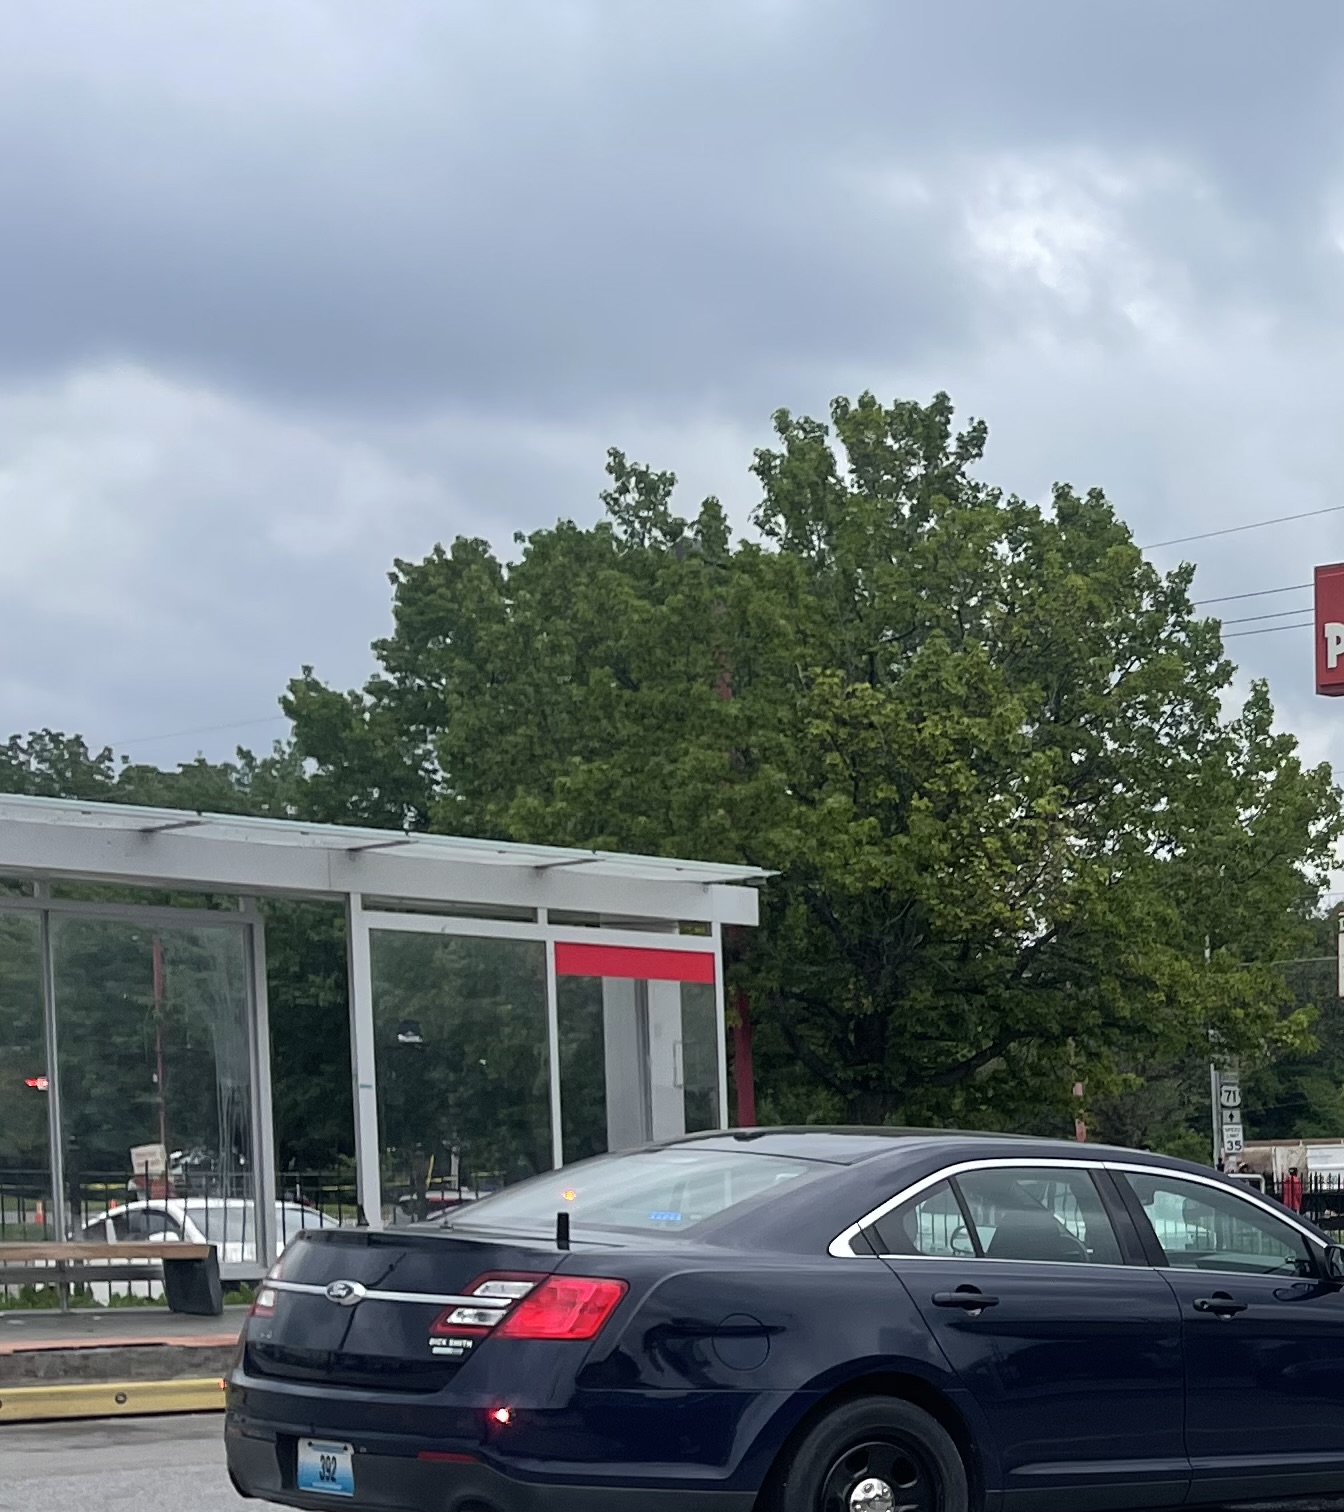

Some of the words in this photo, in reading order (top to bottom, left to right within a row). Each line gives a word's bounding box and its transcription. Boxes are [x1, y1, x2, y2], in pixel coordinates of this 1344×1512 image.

[1223, 1089, 1237, 1103] 71
[1226, 1140, 1242, 1151] 35
[319, 1454, 337, 1482] 392
